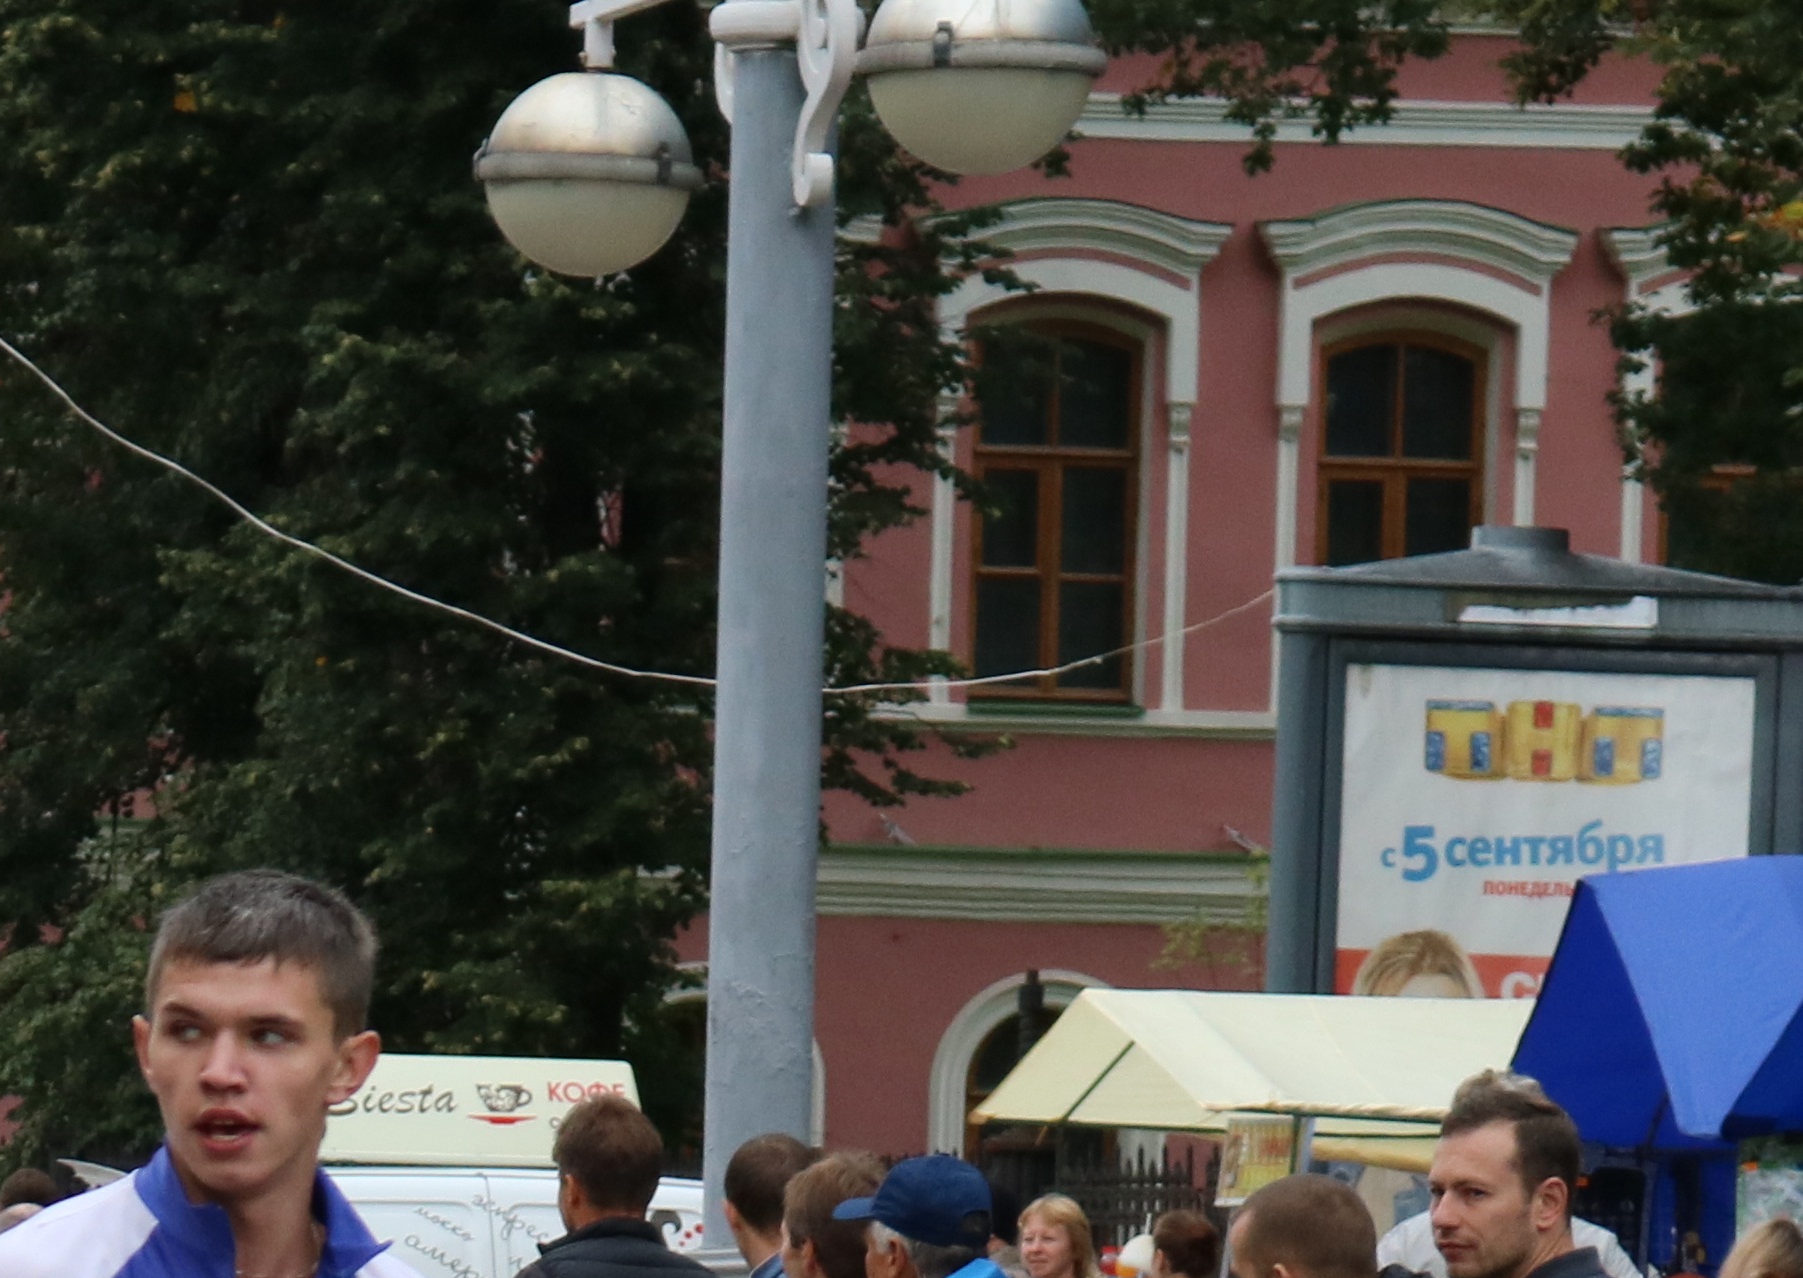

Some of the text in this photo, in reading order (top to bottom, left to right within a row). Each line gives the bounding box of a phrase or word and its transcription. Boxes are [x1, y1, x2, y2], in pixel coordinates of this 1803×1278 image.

[1425, 699, 1665, 784] ТНТ
[1380, 819, 1665, 882] с 5 сентября
